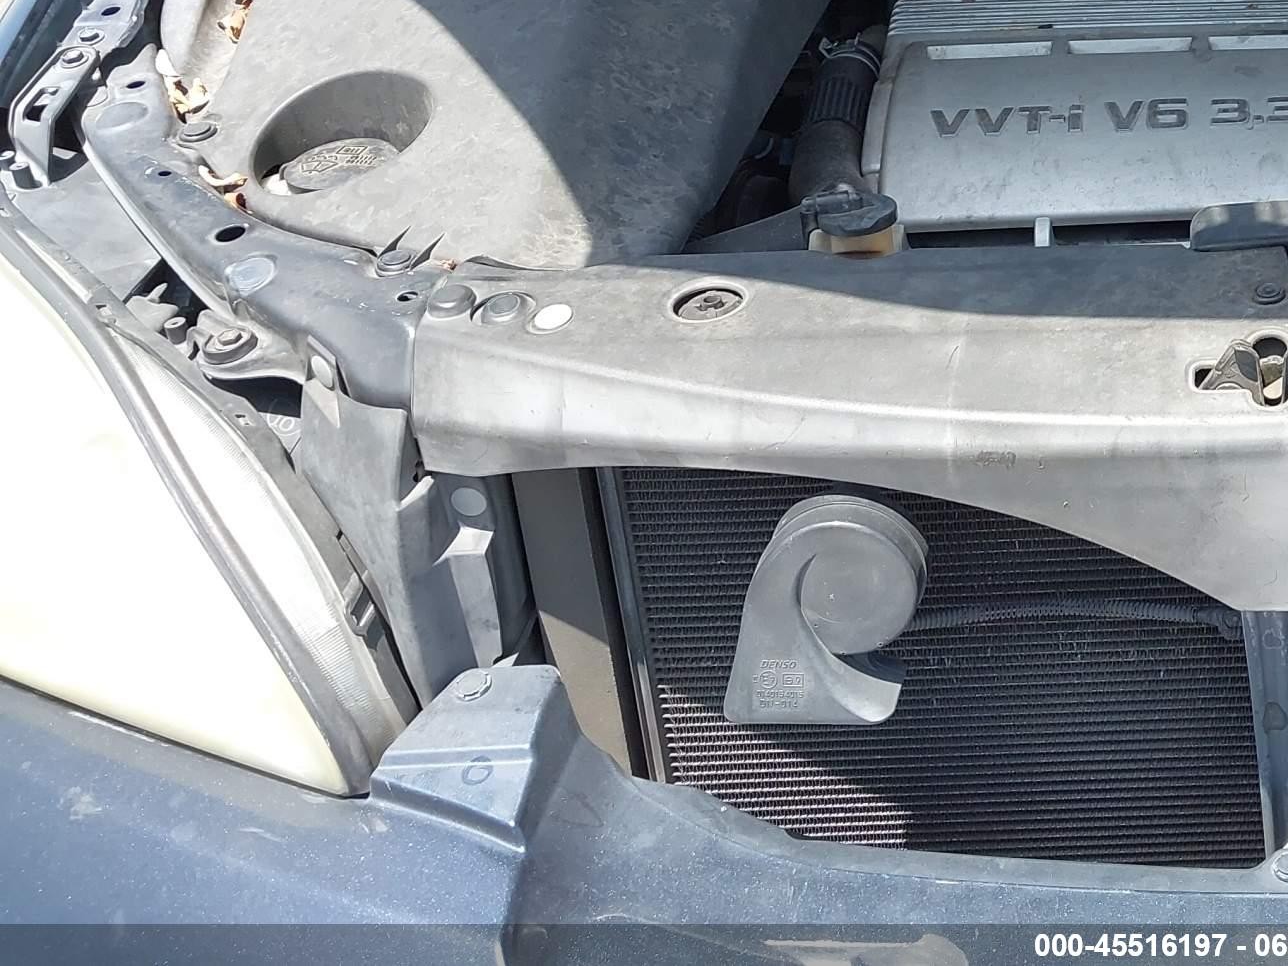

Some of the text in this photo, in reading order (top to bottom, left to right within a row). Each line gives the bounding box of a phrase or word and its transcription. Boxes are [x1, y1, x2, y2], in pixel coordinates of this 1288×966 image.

[930, 104, 1085, 135] VVT-i
[1104, 97, 1188, 133] V6
[759, 659, 798, 669] DENSO
